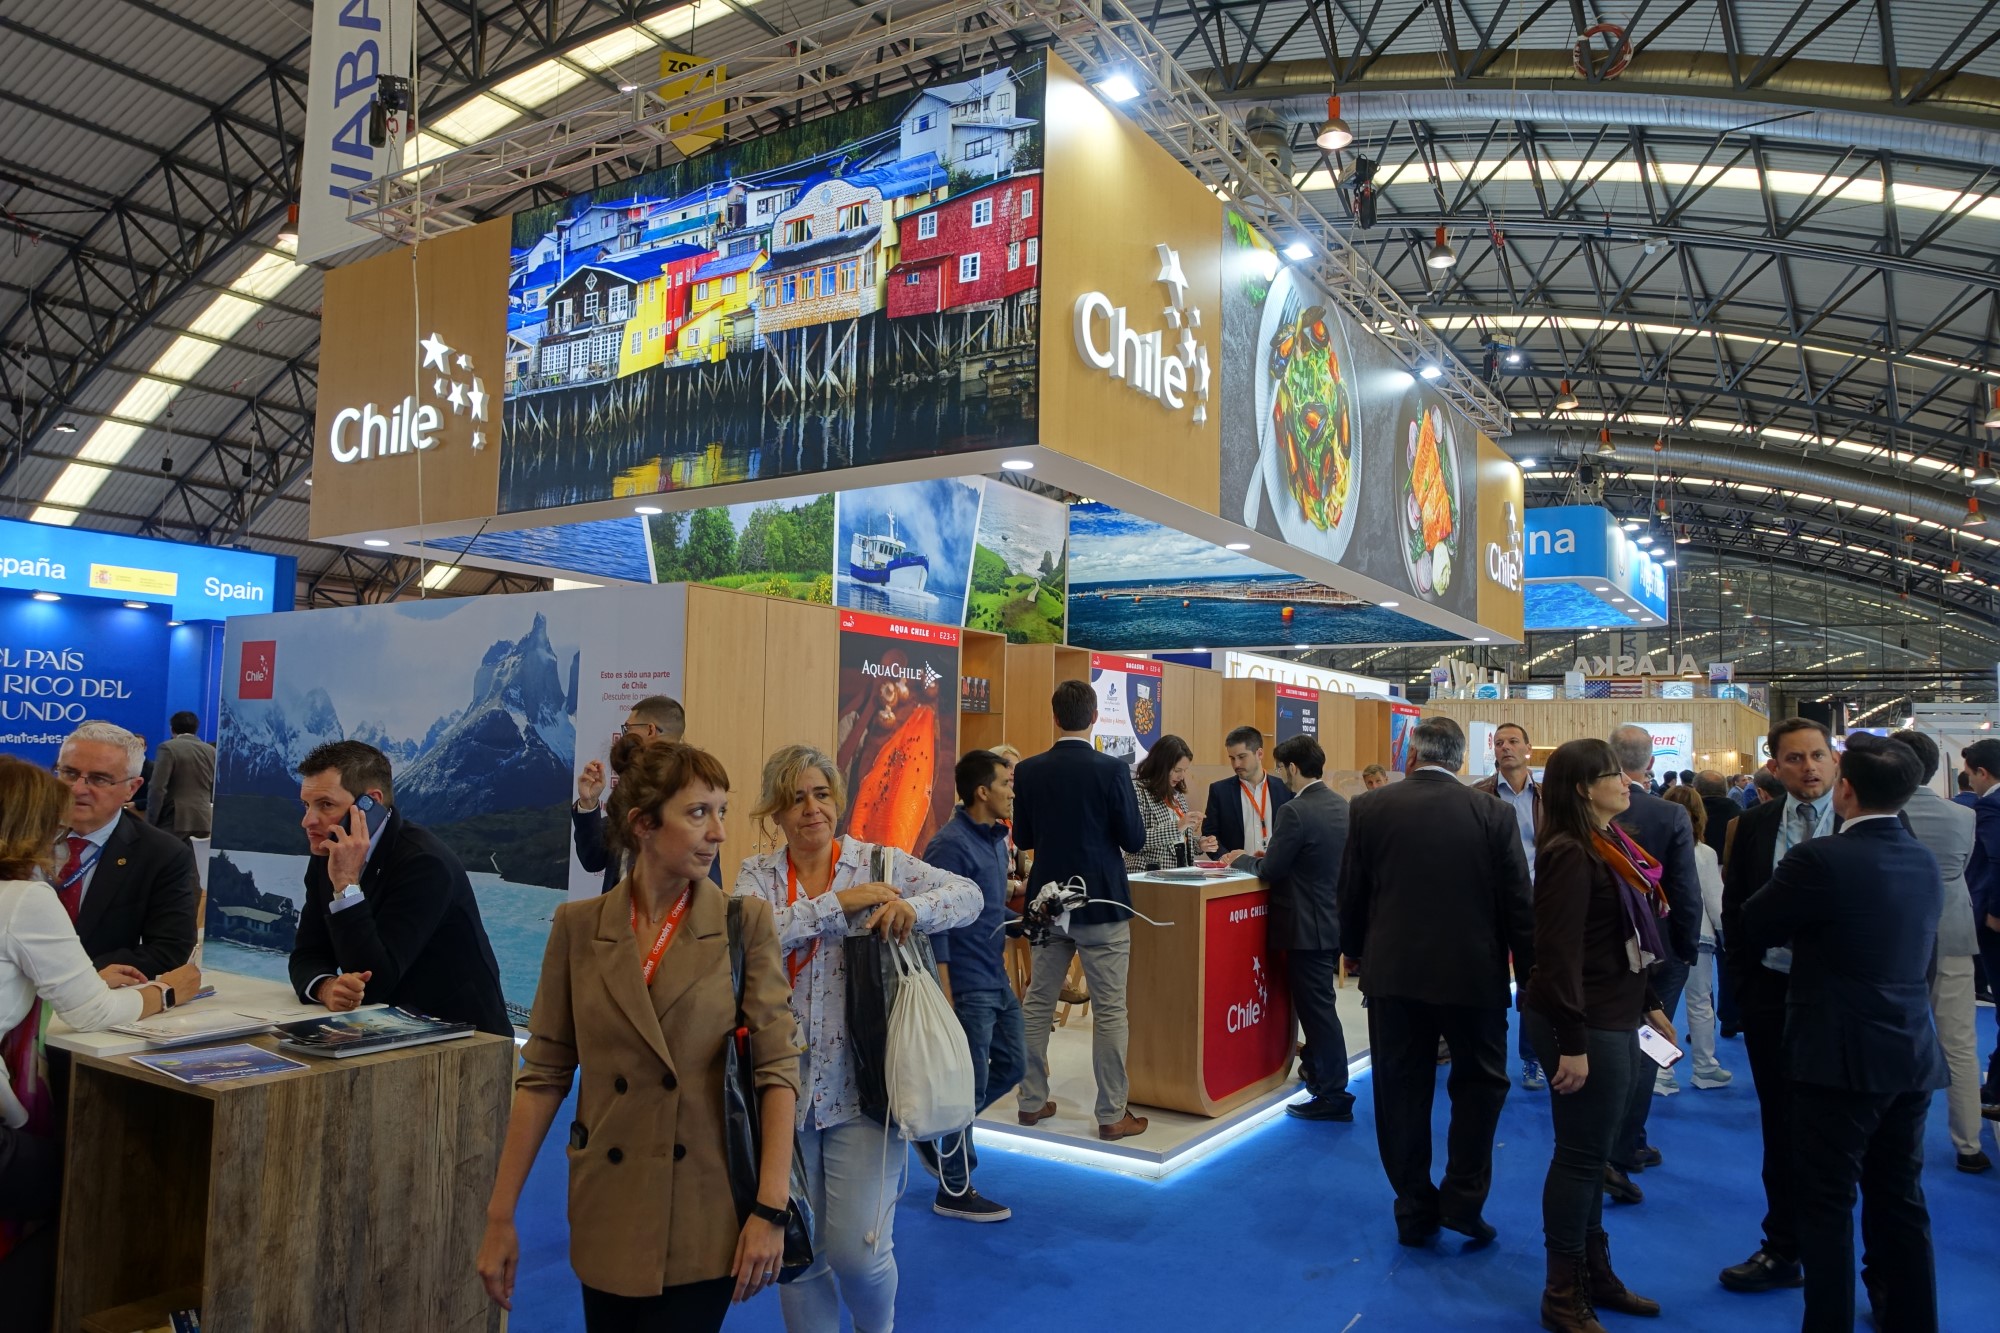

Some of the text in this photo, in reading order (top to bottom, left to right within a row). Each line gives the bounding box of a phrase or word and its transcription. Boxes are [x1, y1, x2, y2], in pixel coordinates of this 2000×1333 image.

[1074, 291, 1187, 409] Chile
[331, 395, 444, 463] Chile
[1525, 527, 1575, 555] na
[1485, 542, 1518, 592] Chile
[204, 576, 264, 602] Spain
[890, 624, 908, 634] AQUA
[910, 627, 930, 637] CHILE
[0, 647, 84, 672] L PAÍS
[3, 674, 133, 699] RICO DEL
[245, 670, 264, 682] Chile
[600, 671, 614, 679] Esto
[652, 670, 671, 680] parte
[621, 681, 648, 690] de Chile
[0, 700, 87, 722] UNDO
[1229, 904, 1268, 924] AQUA CHILE
[1226, 998, 1261, 1034] Chile
